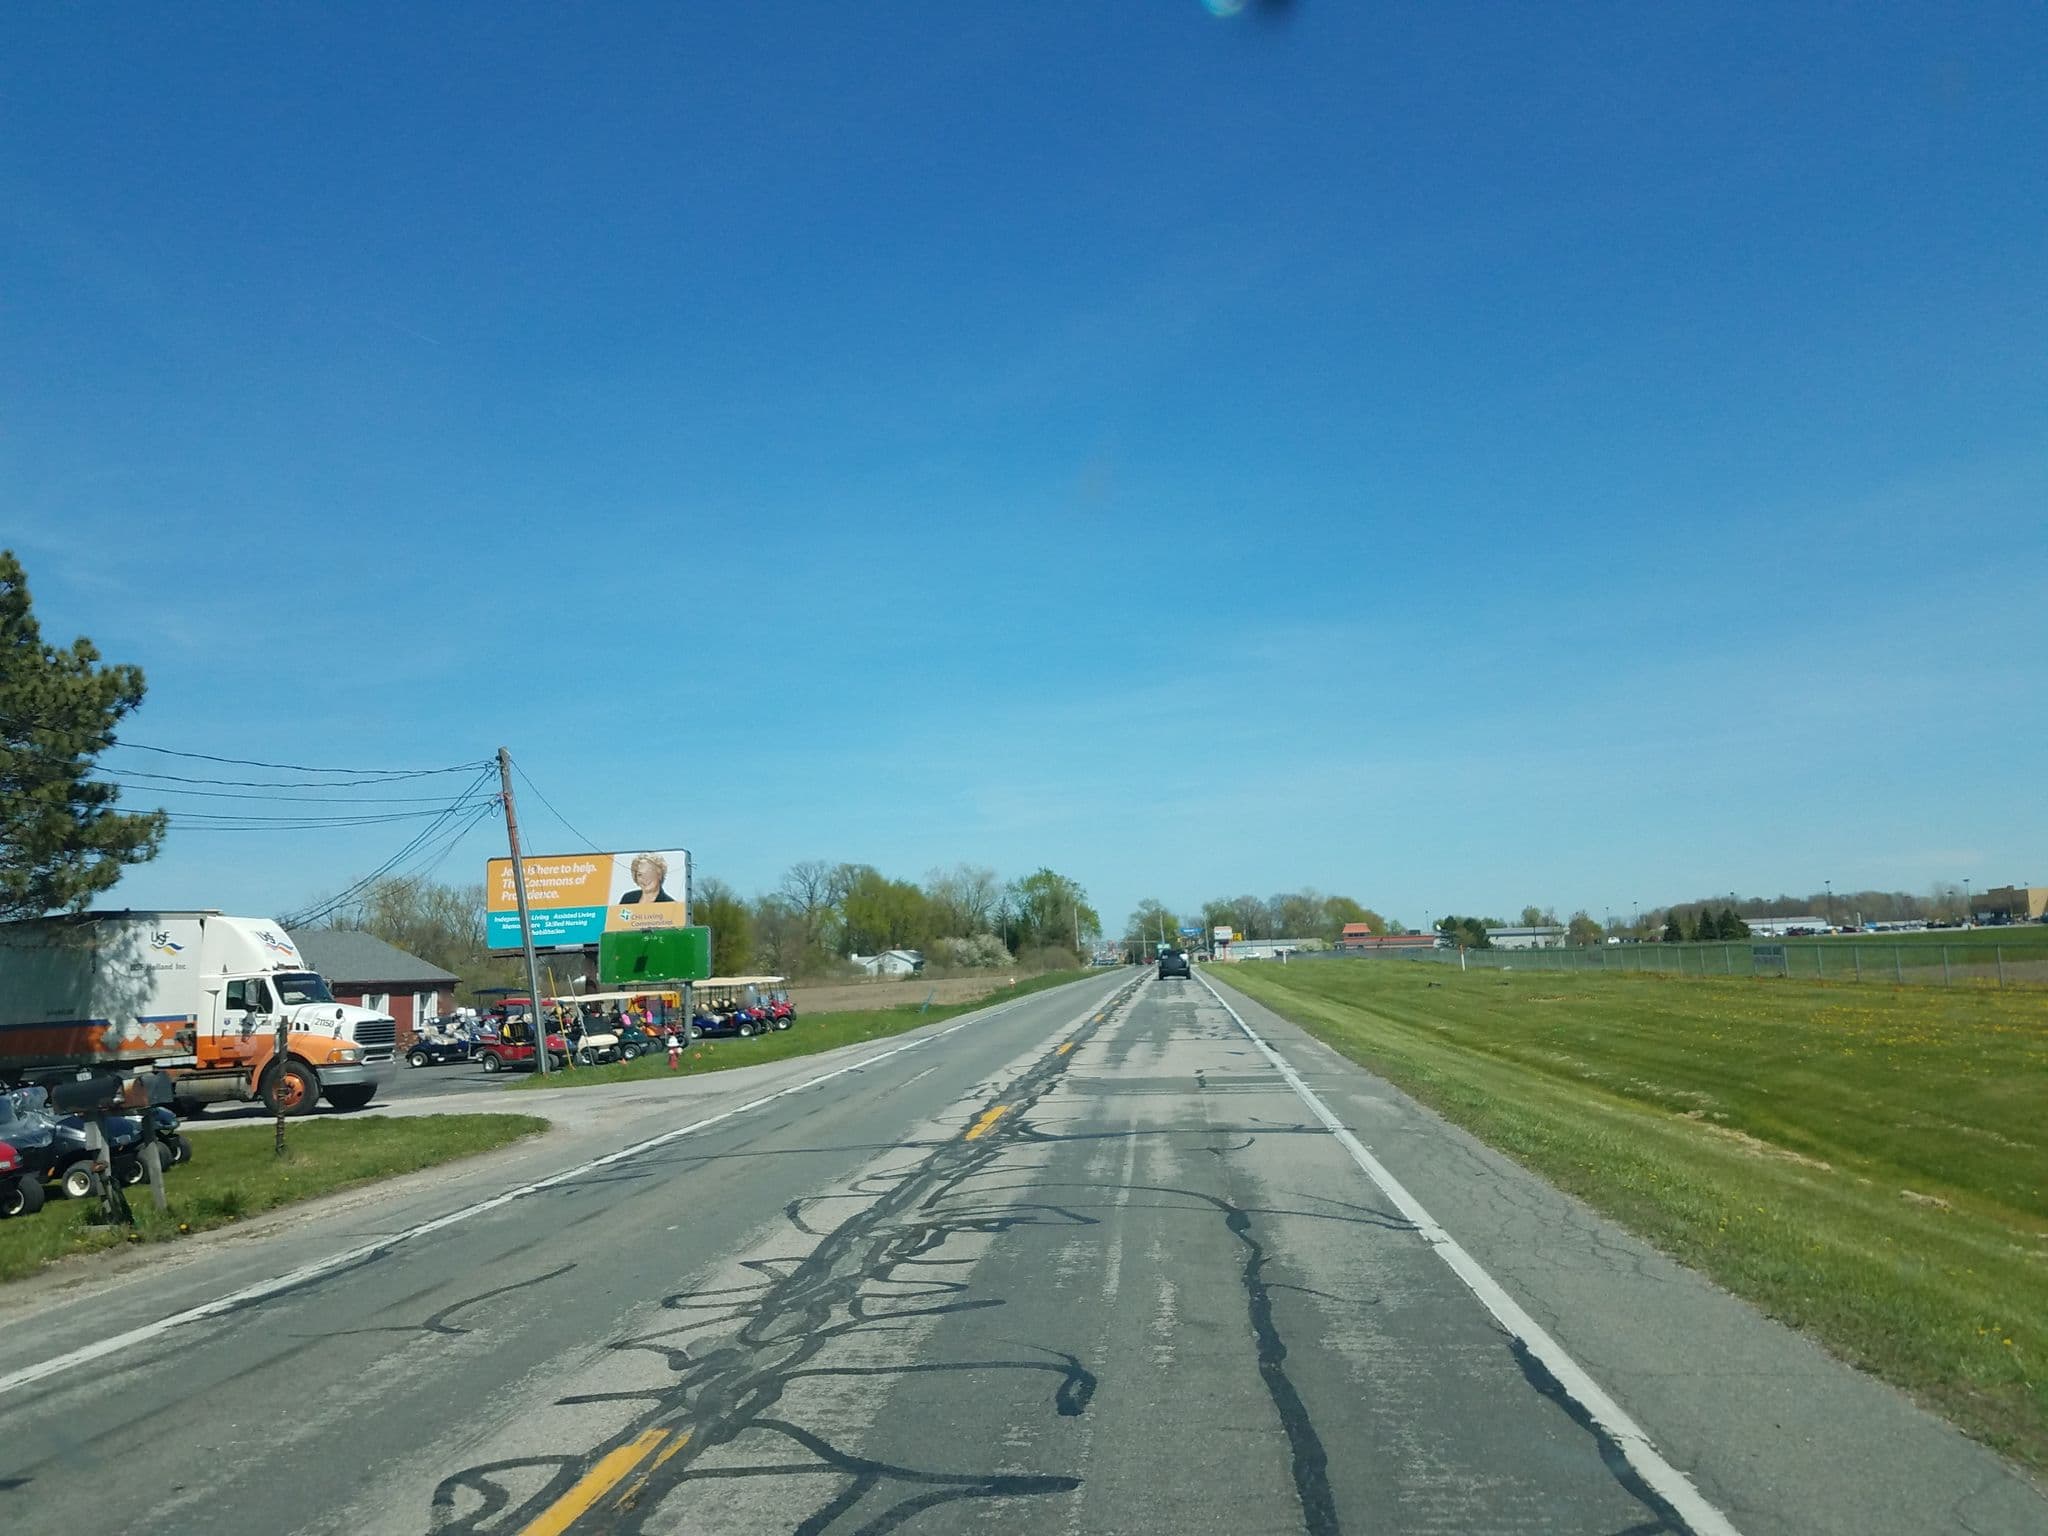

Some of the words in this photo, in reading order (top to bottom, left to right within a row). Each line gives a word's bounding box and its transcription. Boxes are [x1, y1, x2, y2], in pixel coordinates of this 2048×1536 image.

[537, 863, 561, 874] here
[561, 864, 572, 873] to
[573, 862, 598, 873] help.
[575, 874, 587, 884] of
[151, 931, 170, 945] USF
